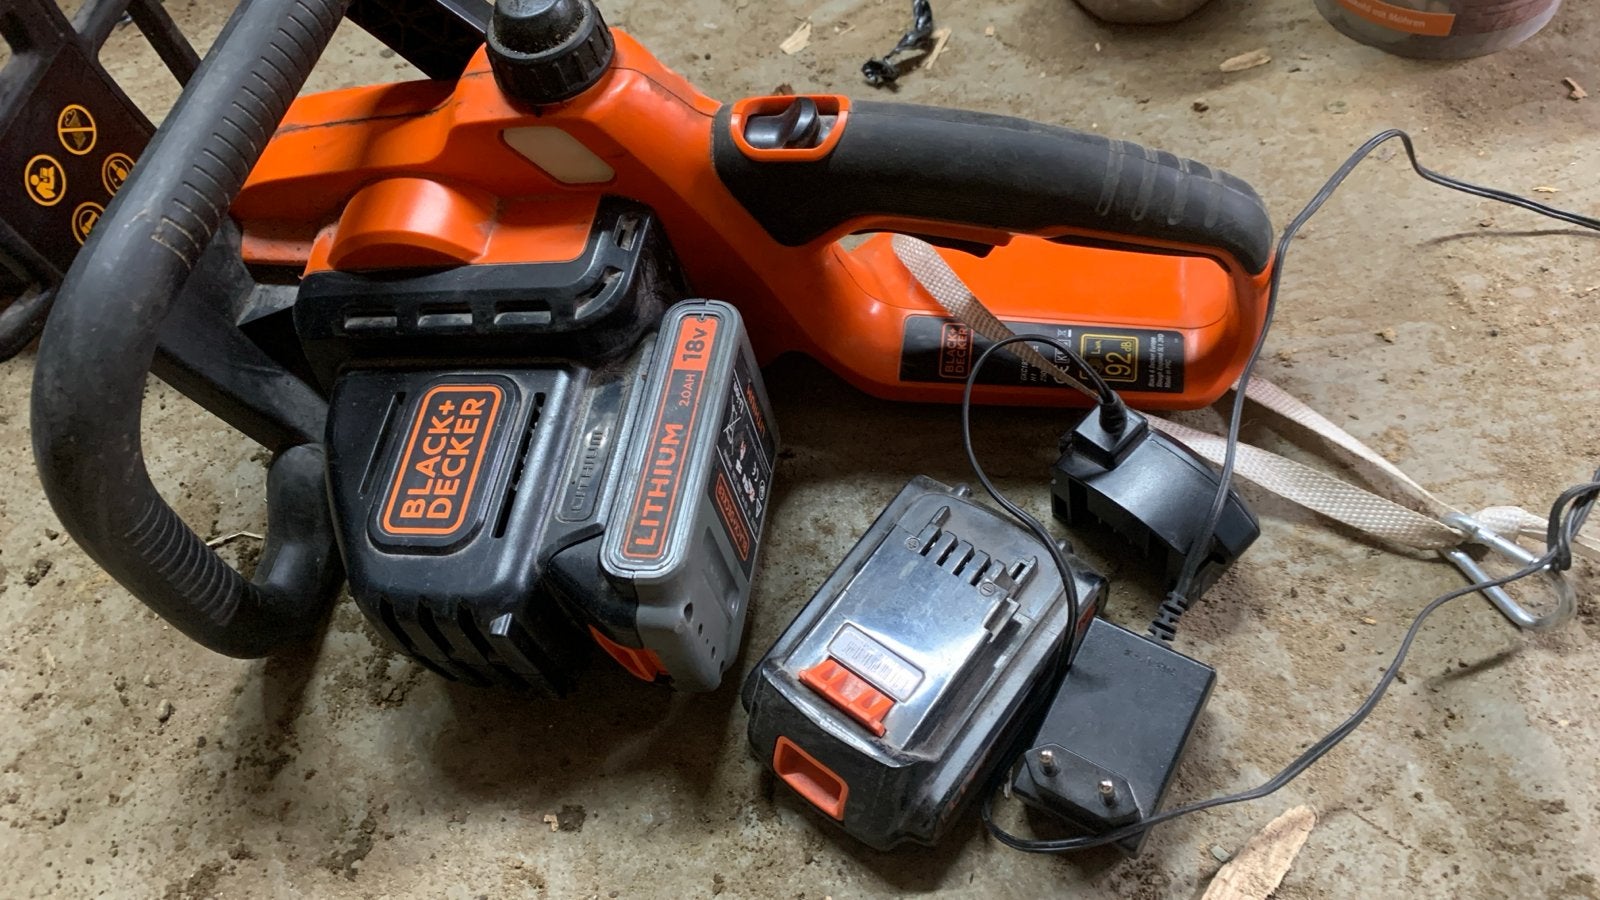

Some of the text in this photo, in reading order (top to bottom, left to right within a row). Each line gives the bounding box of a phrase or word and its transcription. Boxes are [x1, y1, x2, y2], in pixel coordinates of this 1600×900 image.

[944, 328, 958, 373] BLACK+
[955, 327, 968, 373] DECKER
[1105, 352, 1132, 376] 92
[399, 399, 456, 519] BLACK+
[426, 398, 487, 519] DECKER
[635, 423, 685, 547] LITHIUM
